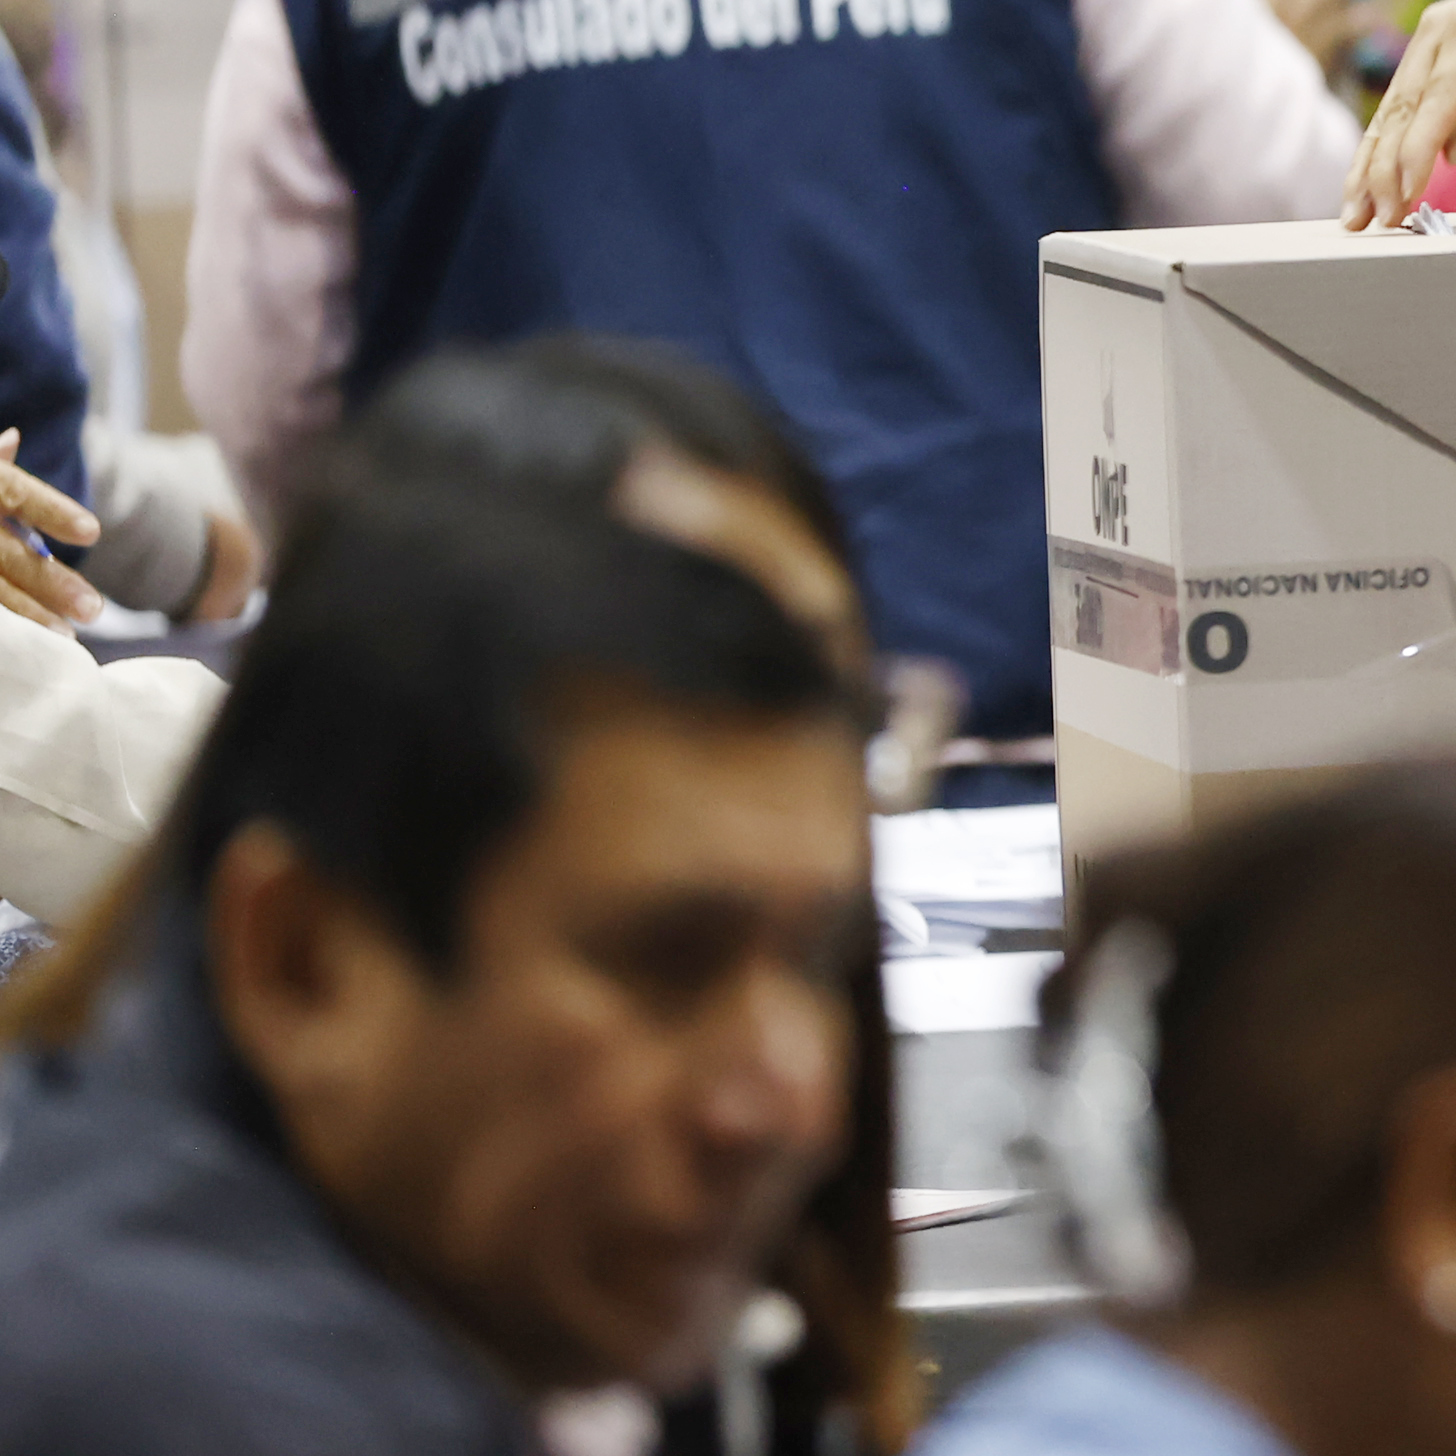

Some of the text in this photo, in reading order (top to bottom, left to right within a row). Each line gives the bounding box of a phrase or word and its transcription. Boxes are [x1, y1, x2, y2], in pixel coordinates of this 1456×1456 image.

[1184, 572, 1317, 599] NACIONAL
[1324, 567, 1429, 592] OFICINA
[1187, 611, 1248, 674] O
